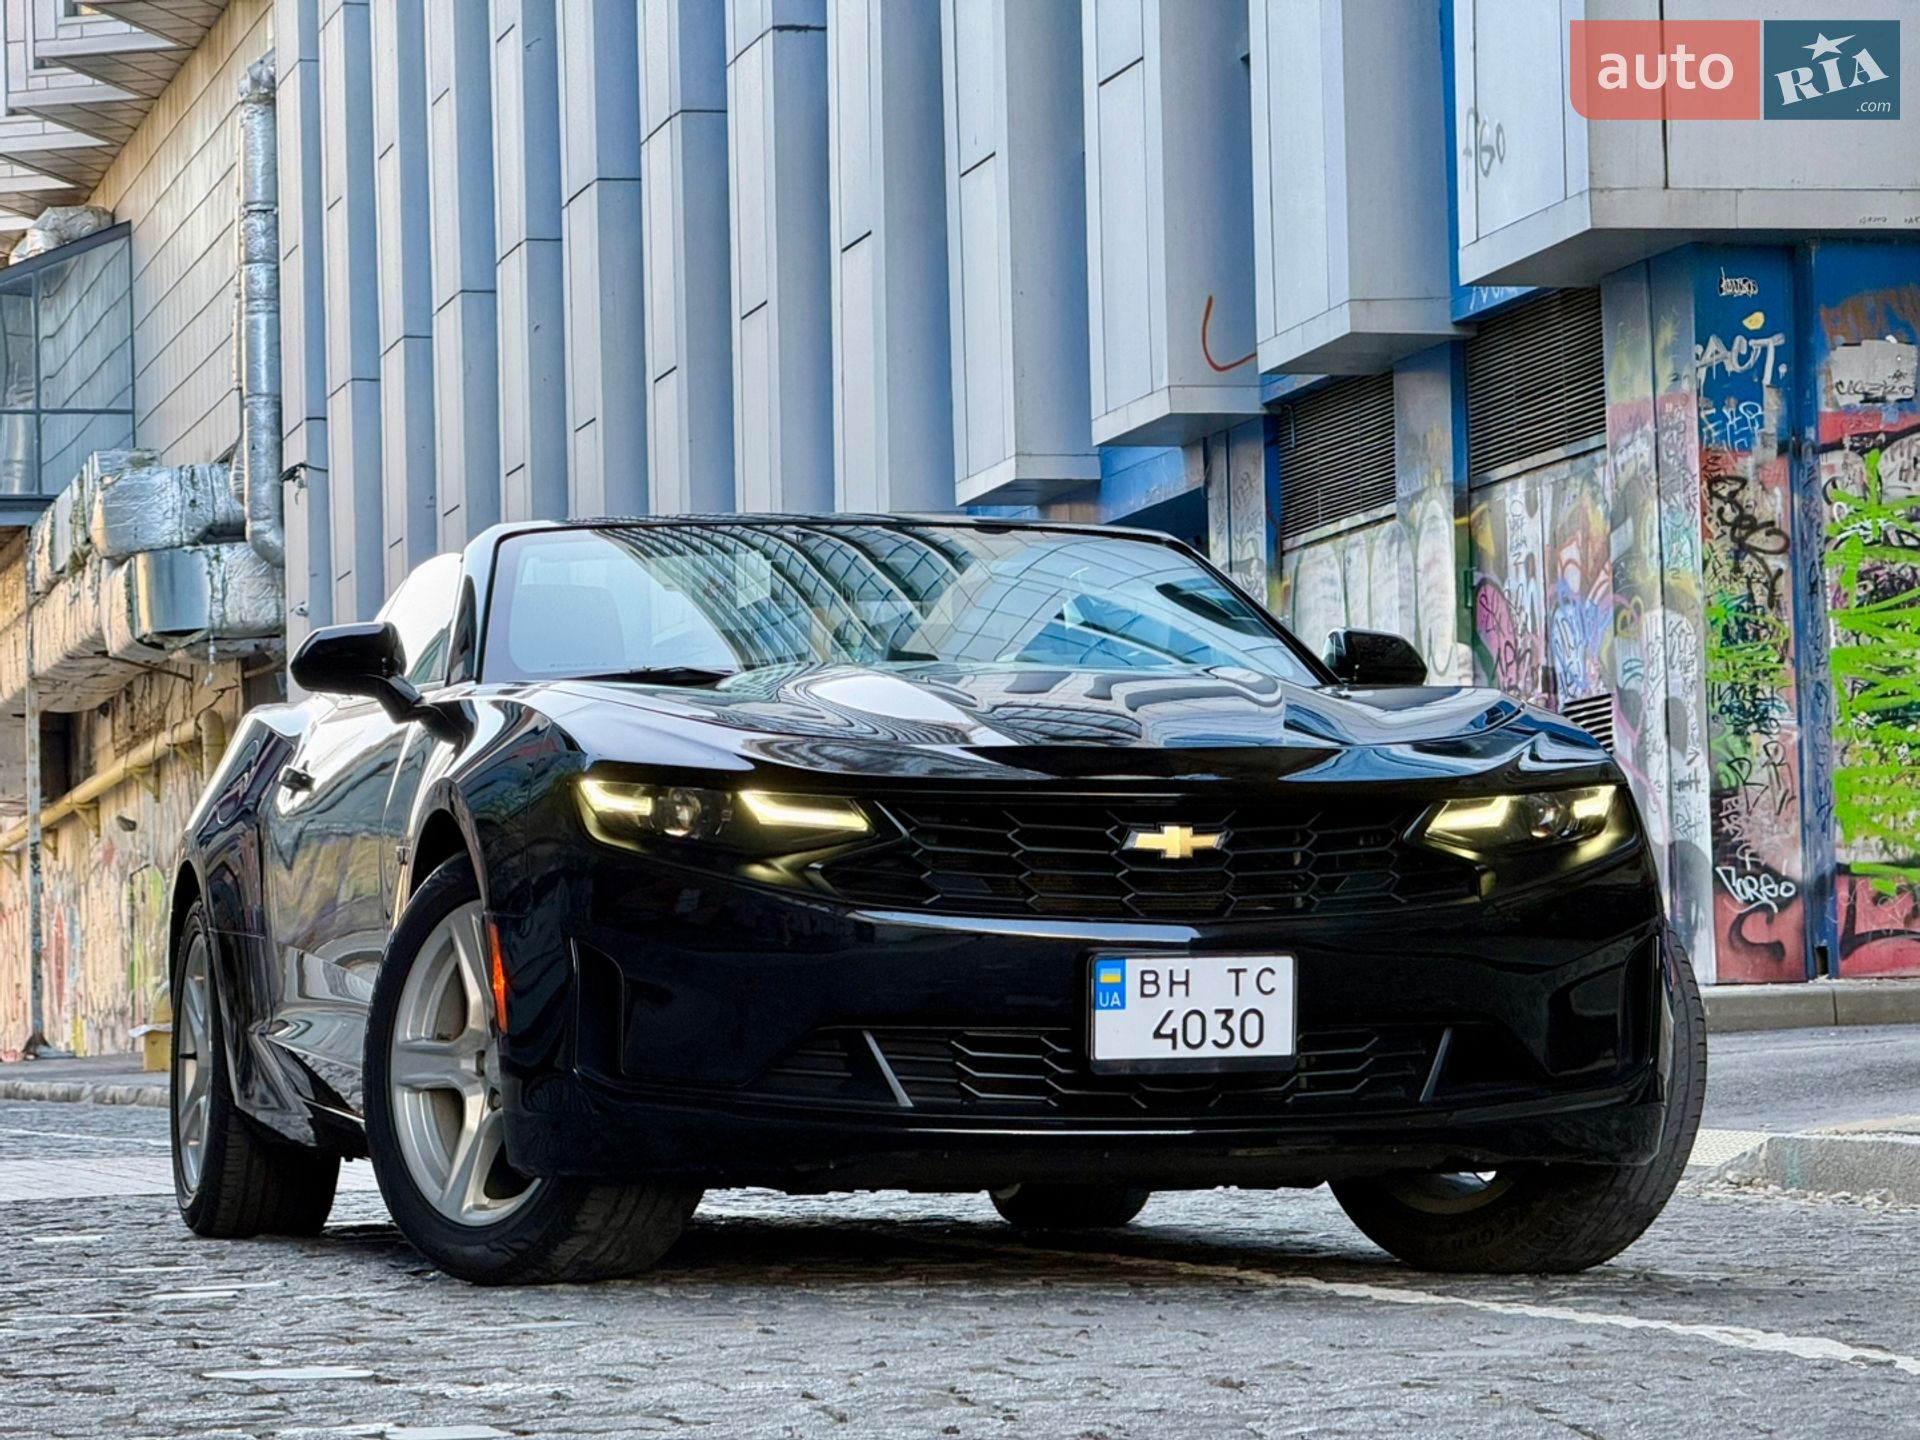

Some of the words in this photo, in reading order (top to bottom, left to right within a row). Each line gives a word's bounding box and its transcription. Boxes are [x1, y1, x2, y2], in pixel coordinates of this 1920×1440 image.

[1139, 968, 1190, 998] BH
[1227, 966, 1276, 996] TC
[1099, 992, 1121, 1007] UA
[1153, 1008, 1264, 1051] 4030
